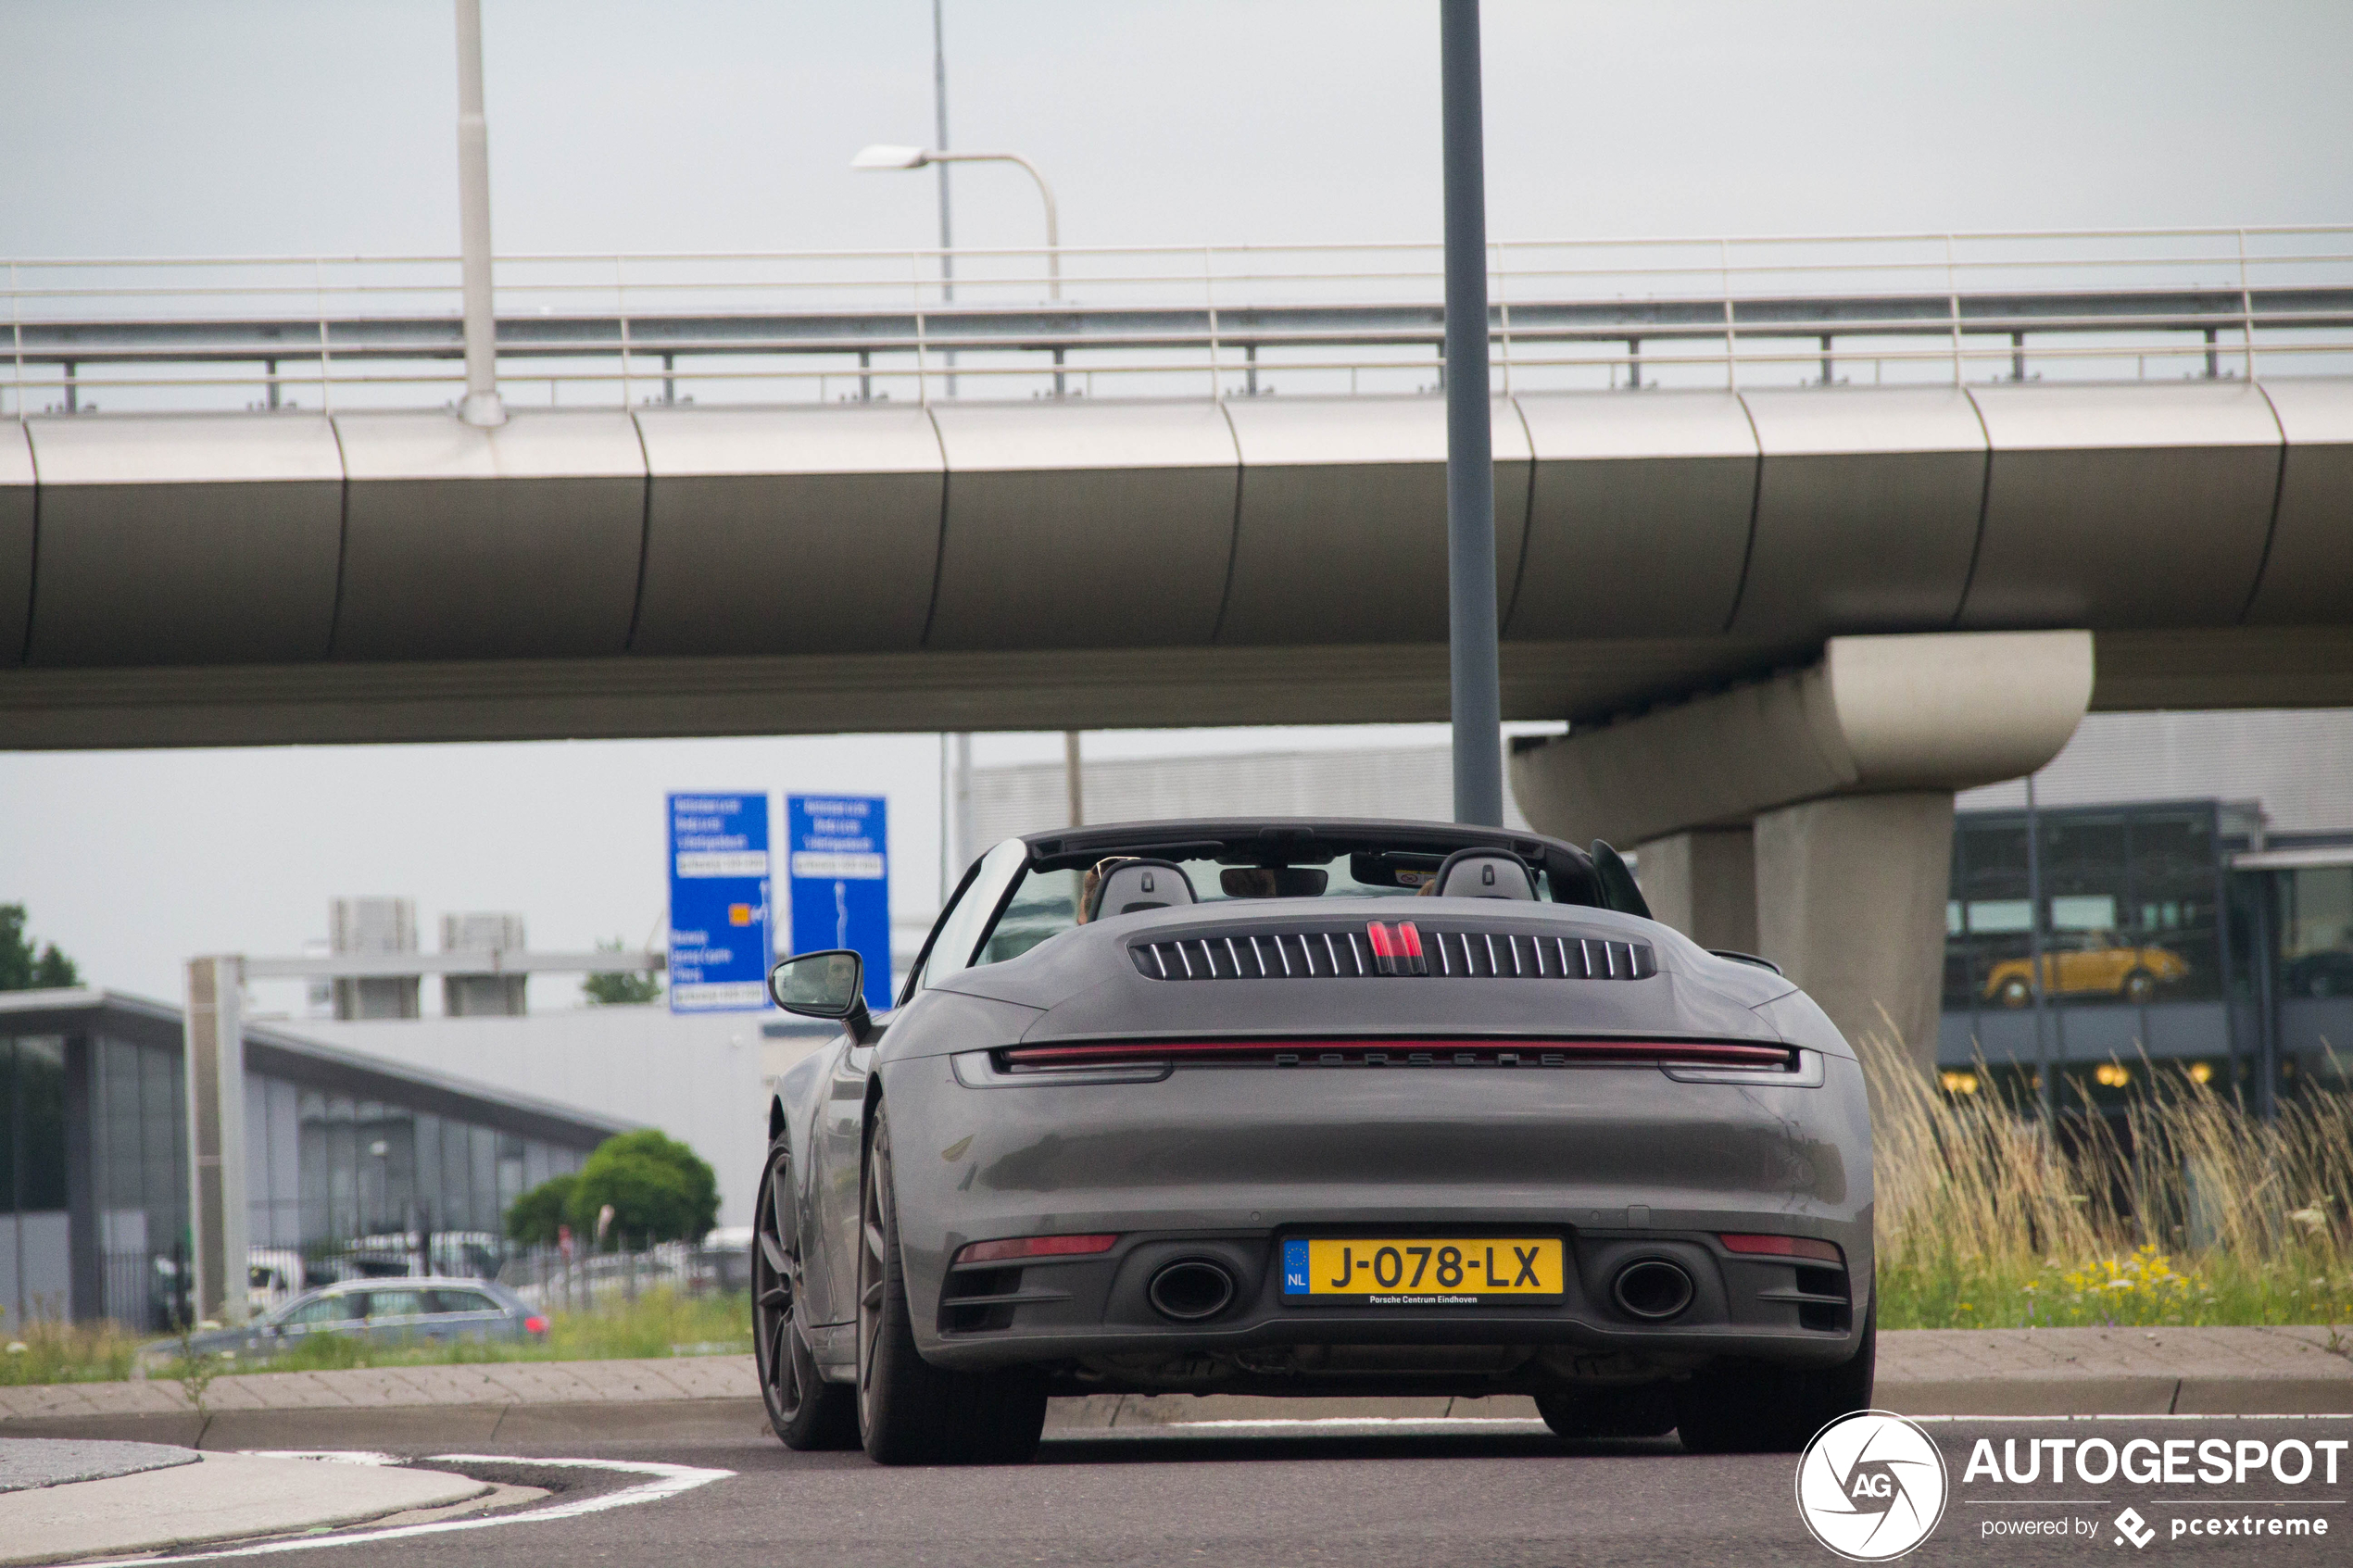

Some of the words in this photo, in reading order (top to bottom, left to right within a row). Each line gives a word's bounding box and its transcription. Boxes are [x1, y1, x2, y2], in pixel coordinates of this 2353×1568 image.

[1275, 1053, 1565, 1066] PORSCHE
[1331, 1246, 1541, 1288] J-078-LX
[1288, 1273, 1306, 1286] NL
[1369, 1295, 1402, 1304] Porsche
[1402, 1295, 1436, 1304] Centrum
[1437, 1295, 1478, 1304] Eindhoven
